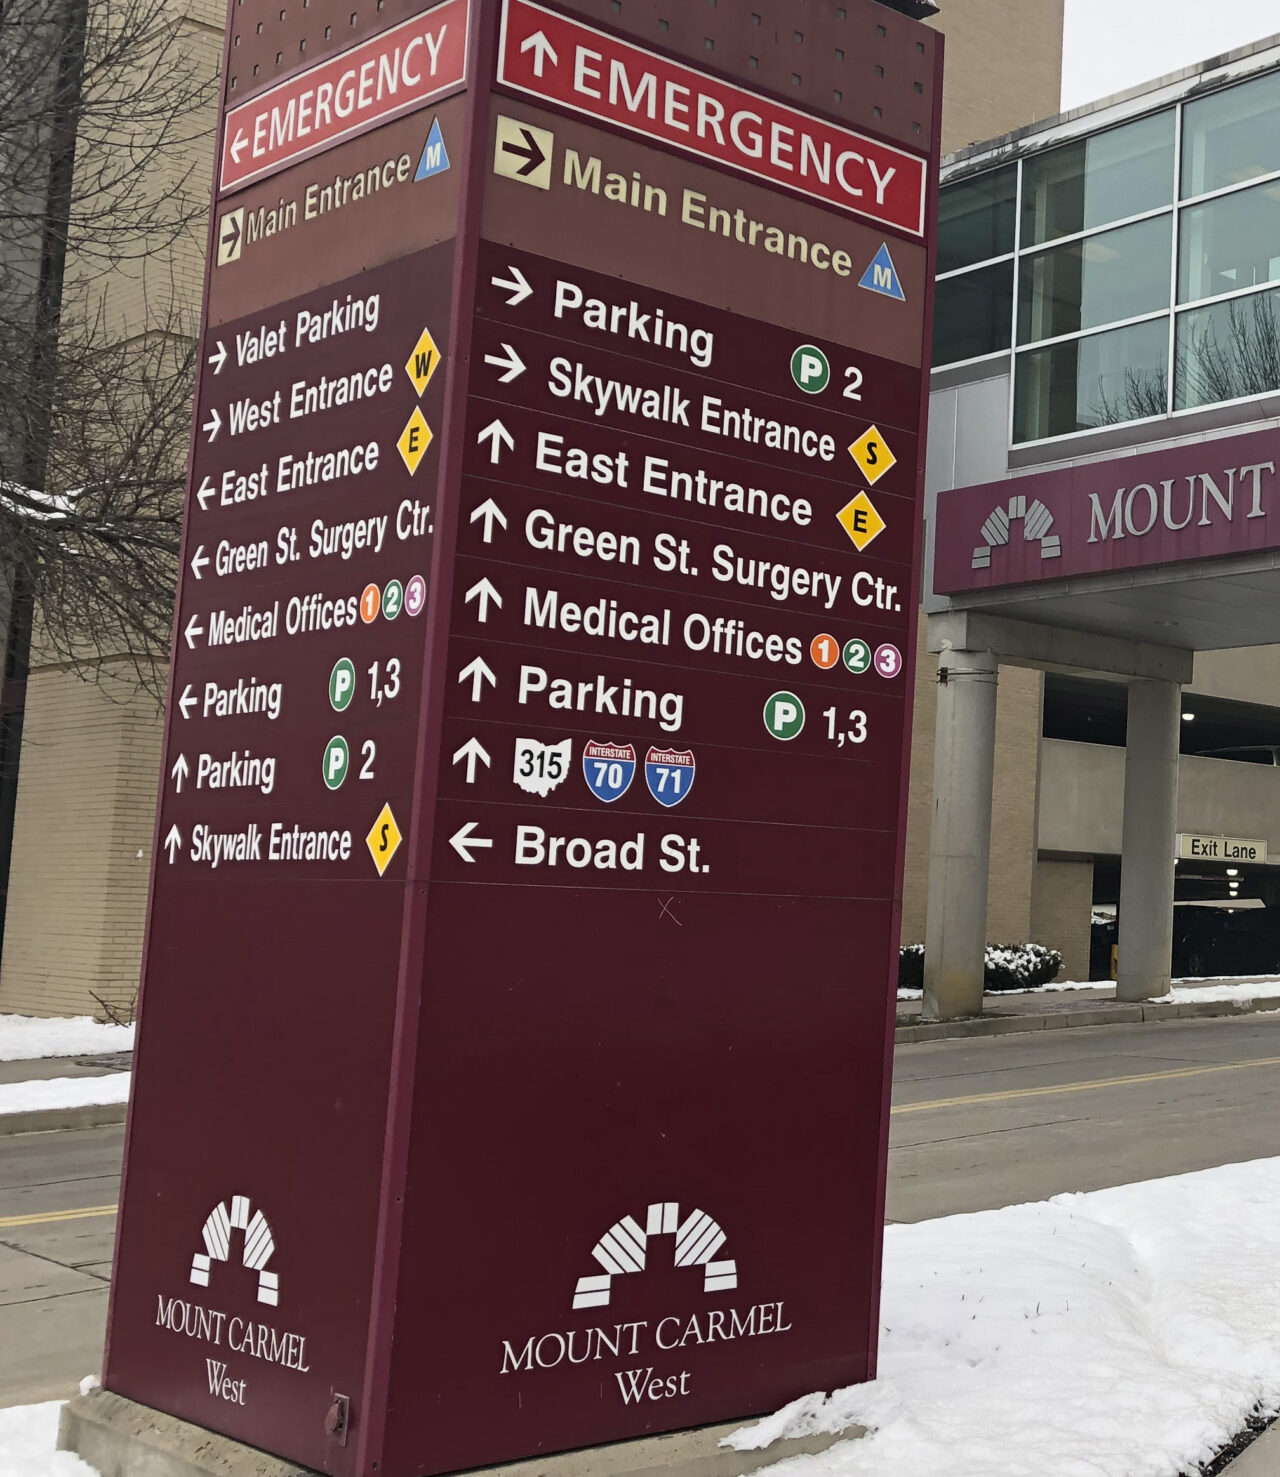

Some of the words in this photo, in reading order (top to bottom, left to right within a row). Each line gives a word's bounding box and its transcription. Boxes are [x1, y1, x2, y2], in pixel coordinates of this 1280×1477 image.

[252, 24, 447, 158] EMERGENCY
[573, 44, 896, 205] EMERGENCY
[247, 199, 296, 244] Main
[304, 153, 411, 222] Entrance
[426, 141, 440, 170] M
[563, 148, 667, 216] Main
[681, 188, 852, 277] Entrance
[873, 264, 892, 290] M
[235, 321, 286, 366] Valet
[295, 293, 380, 347] Parking
[553, 279, 714, 367] Parking
[800, 353, 823, 384] P
[843, 367, 863, 401] 2
[229, 391, 280, 436] West
[290, 363, 393, 419] Entrance
[415, 350, 433, 378] W
[548, 356, 690, 426] Skywalk
[701, 396, 836, 462] Entrance
[866, 441, 877, 466] S
[220, 464, 267, 506] East
[277, 441, 379, 493] Entrance
[408, 426, 420, 453] E
[535, 431, 629, 488] East
[642, 456, 812, 526] Entrance
[853, 509, 868, 534] E
[1087, 462, 1275, 543] MOUNT
[216, 539, 268, 577] Green
[276, 526, 300, 565] St.
[310, 514, 387, 559] Surgery
[396, 500, 434, 540] Ctr.
[525, 508, 640, 564] Green
[653, 533, 699, 575] St.
[711, 543, 842, 609] Surgery
[851, 571, 902, 612] Ctr.
[208, 600, 278, 647] Medical
[286, 593, 357, 635] Offices
[365, 590, 375, 616] 1
[386, 587, 399, 613] 2
[408, 582, 422, 608] 3
[524, 586, 671, 647] Medical
[683, 613, 803, 665] Offices
[818, 639, 832, 664] 1
[849, 644, 865, 668] 2
[880, 649, 896, 673] 3
[203, 677, 282, 720] Parking
[335, 670, 351, 701] P
[367, 658, 401, 707] 1,3
[518, 664, 684, 732] Parking
[774, 702, 797, 731] P
[823, 706, 868, 748] 1,3
[196, 750, 275, 794] Parking
[328, 747, 344, 779] P
[359, 740, 375, 780] 2
[519, 749, 562, 780] 315
[589, 745, 631, 760] INTERSTATE
[593, 762, 623, 788] 70
[650, 751, 691, 766] INTERSTATE
[656, 769, 682, 793] 71
[190, 823, 261, 868] Skywalk
[269, 822, 351, 861] Entrance
[379, 823, 389, 852] S
[514, 825, 645, 871] Broad
[659, 833, 710, 873] St.
[1191, 839, 1217, 856] Exit
[1224, 841, 1256, 859] Lane
[156, 1294, 227, 1348] MOUNT
[228, 1316, 310, 1373] CARMEL
[500, 1321, 648, 1375] MOUNT
[655, 1301, 793, 1351] CARMEL
[205, 1358, 247, 1407] West
[614, 1368, 690, 1405] West
